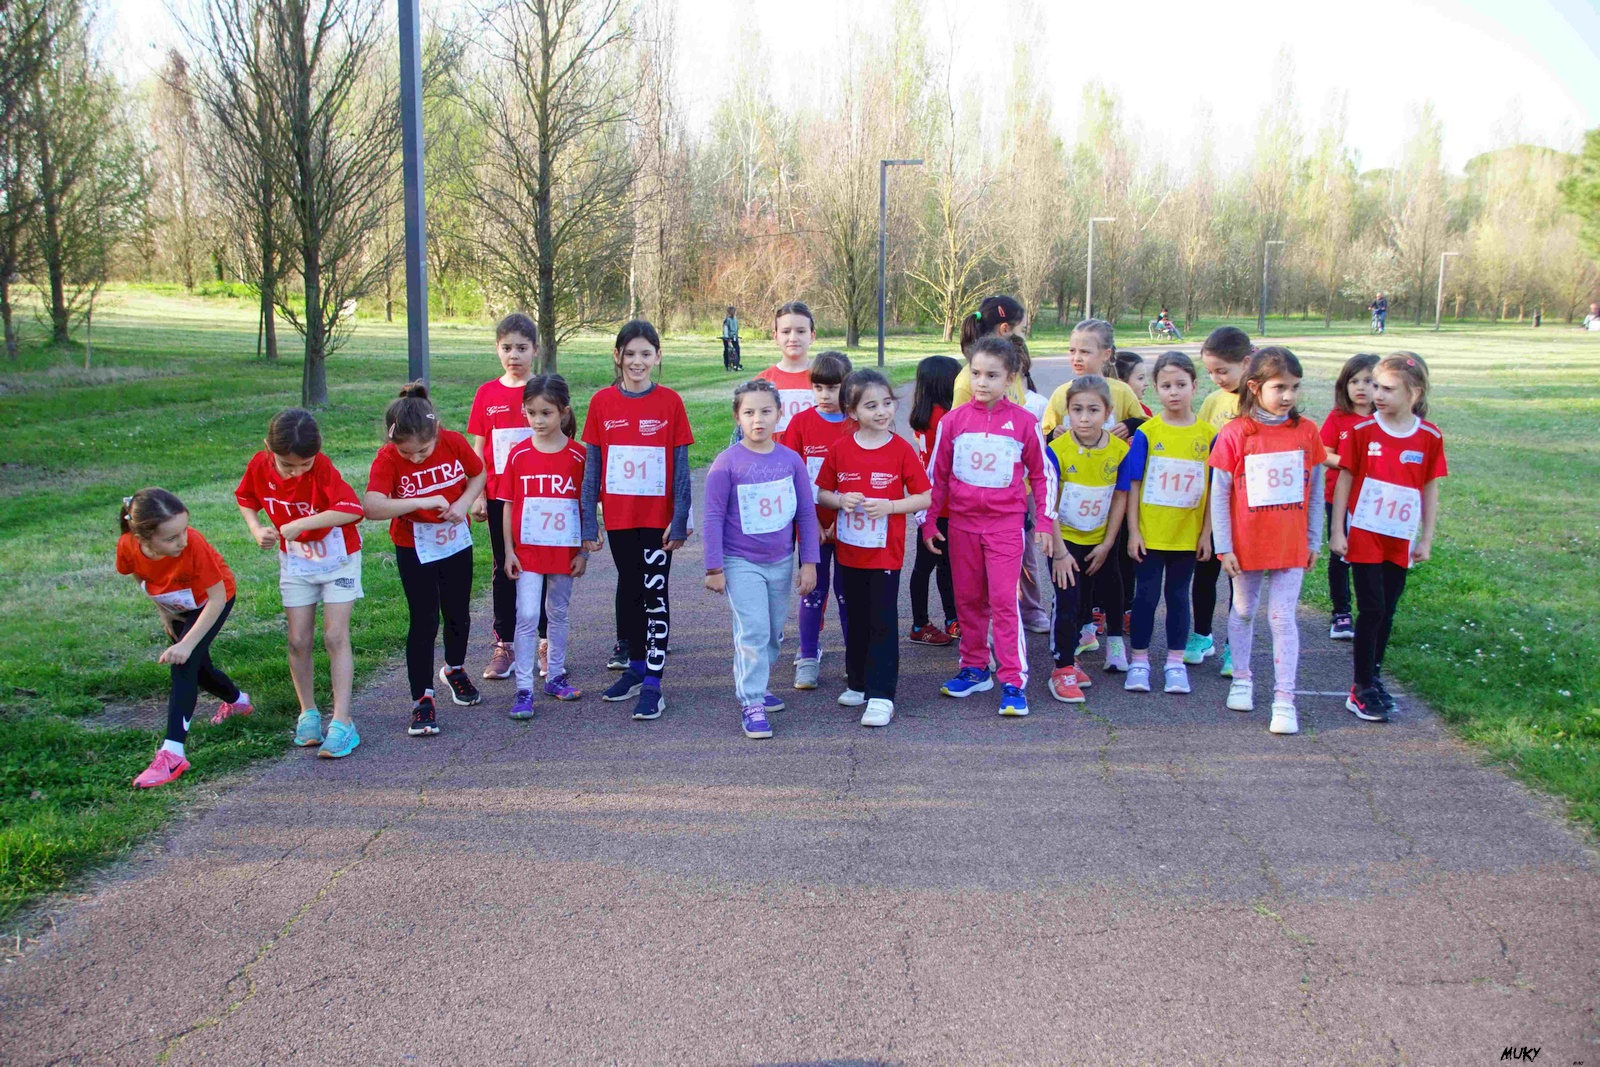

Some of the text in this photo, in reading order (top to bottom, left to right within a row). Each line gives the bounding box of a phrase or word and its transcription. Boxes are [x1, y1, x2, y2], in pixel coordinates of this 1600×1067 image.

[623, 460, 647, 480] 91
[970, 451, 997, 472] 92
[520, 474, 576, 494] TTRA
[1159, 472, 1195, 492] 117
[1267, 467, 1293, 488] 85
[759, 495, 782, 517] 81
[1078, 500, 1102, 517] 55
[1373, 497, 1412, 522] 116
[540, 512, 566, 531] 78
[435, 525, 457, 545] 56
[300, 541, 327, 559] 90
